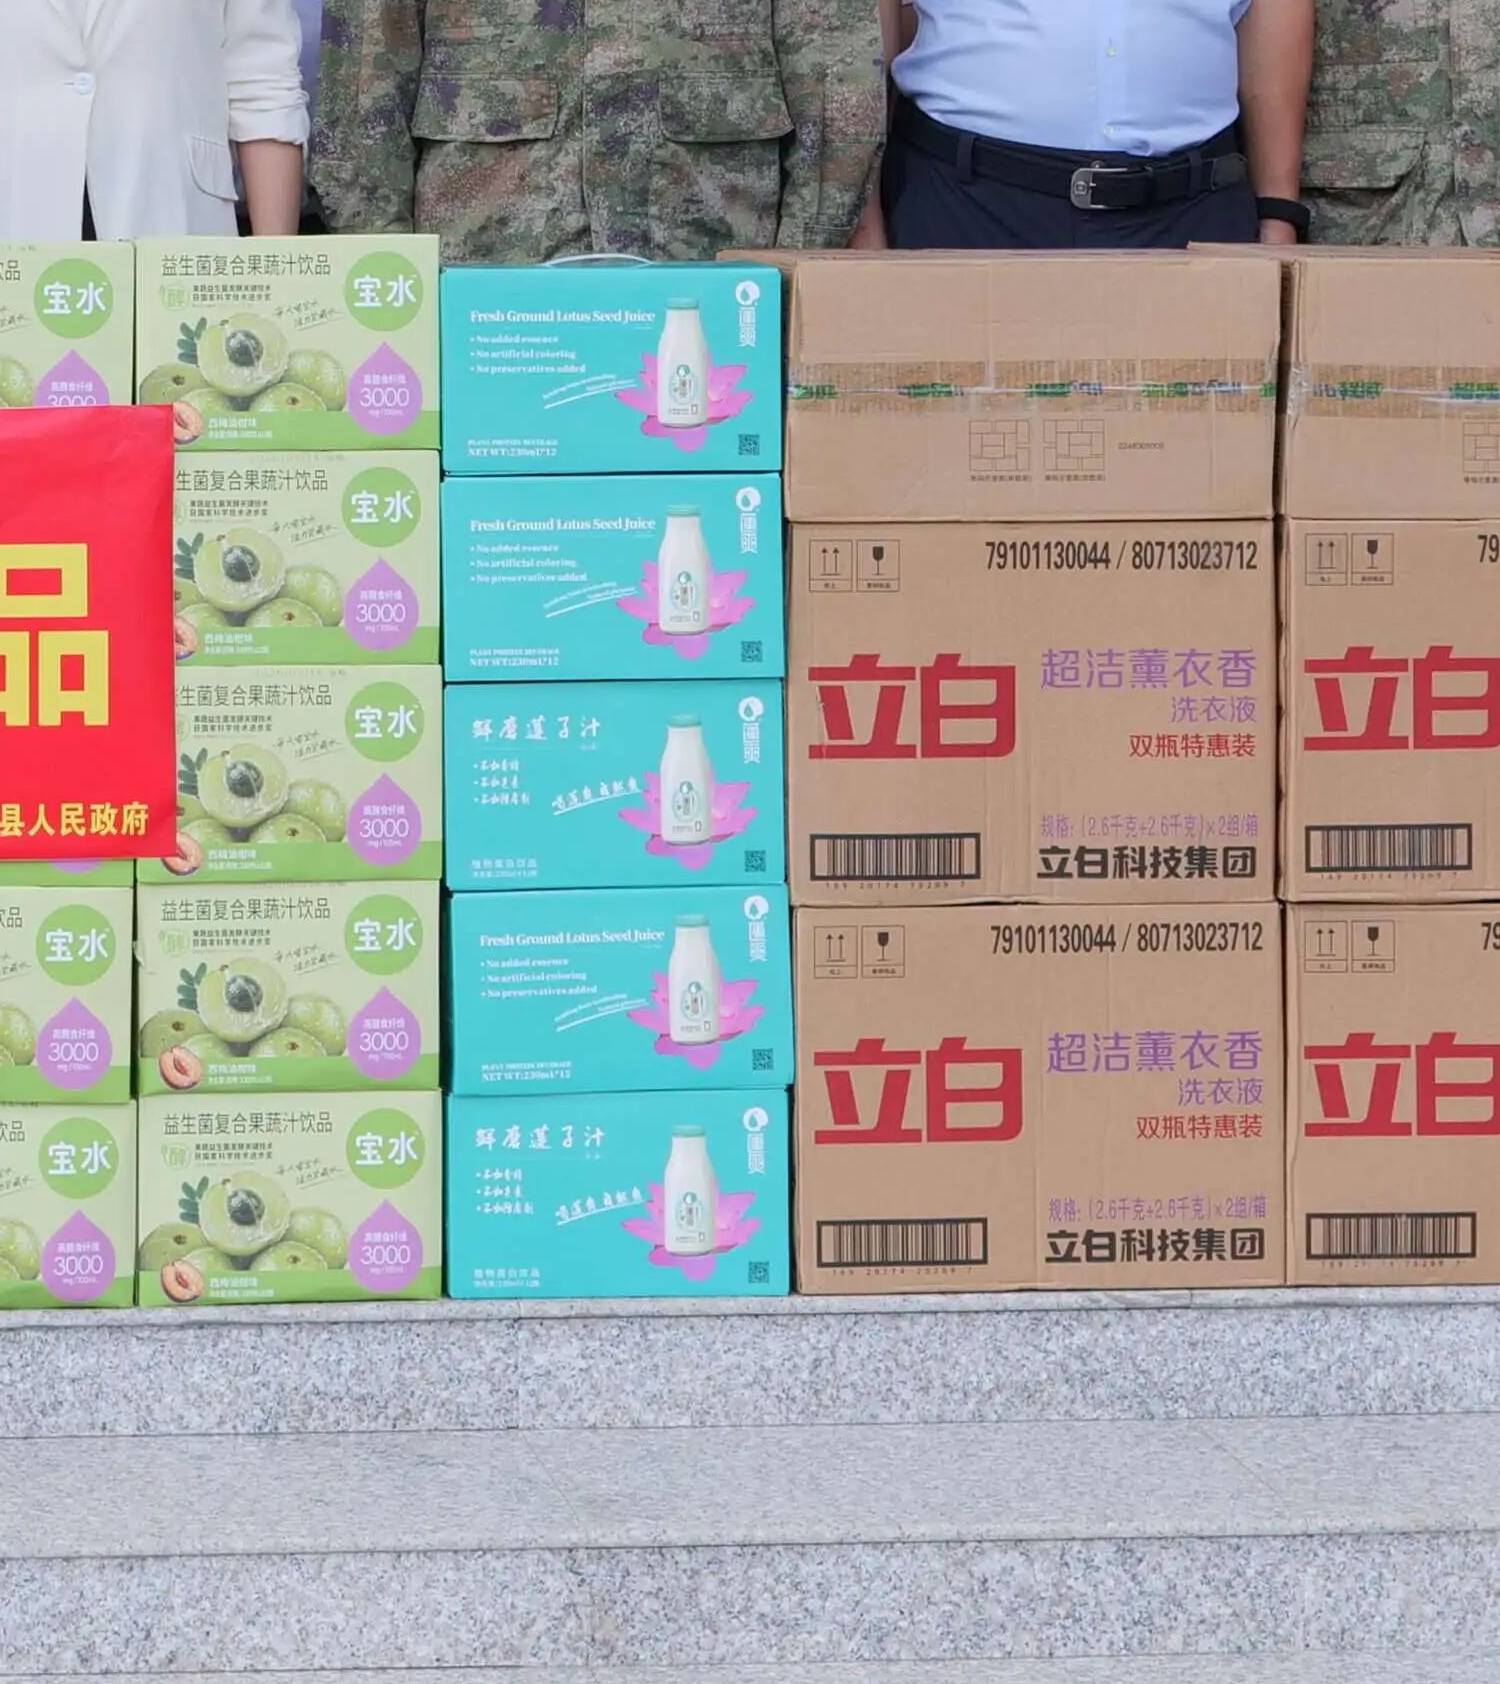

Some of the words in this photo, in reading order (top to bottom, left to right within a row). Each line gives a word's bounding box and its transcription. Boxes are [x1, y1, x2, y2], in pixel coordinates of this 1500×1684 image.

[161, 253, 331, 277] 益生菌复合果蔬汁饮品
[42, 280, 107, 315] 宝水
[352, 273, 417, 308] 宝水
[350, 490, 415, 524] 宝水
[985, 541, 1110, 571] 79101130044
[1131, 540, 1257, 570] 80713023712
[1040, 648, 1257, 689] 超洁薰衣香
[808, 653, 1016, 759] 立白
[1170, 696, 1257, 724] 洗衣液
[1129, 733, 1256, 758] 双瓶特惠装
[1037, 846, 1257, 879] 立白科技集团
[161, 897, 331, 922] 益生菌复合果蔬汁饮品
[45, 928, 110, 962] 宝水
[353, 918, 418, 953] 宝水
[990, 924, 1116, 954] 79101130044
[1137, 922, 1263, 952] 80713023712
[48, 1041, 100, 1063] 3000
[1047, 1030, 1263, 1073] 超洁薰衣香
[814, 1036, 1023, 1144] 立白
[1177, 1078, 1263, 1106] 洗衣液
[1136, 1115, 1263, 1141] 双瓶特惠装
[47, 1141, 112, 1175] 宝水
[1045, 1228, 1265, 1263] 立白科技集团
